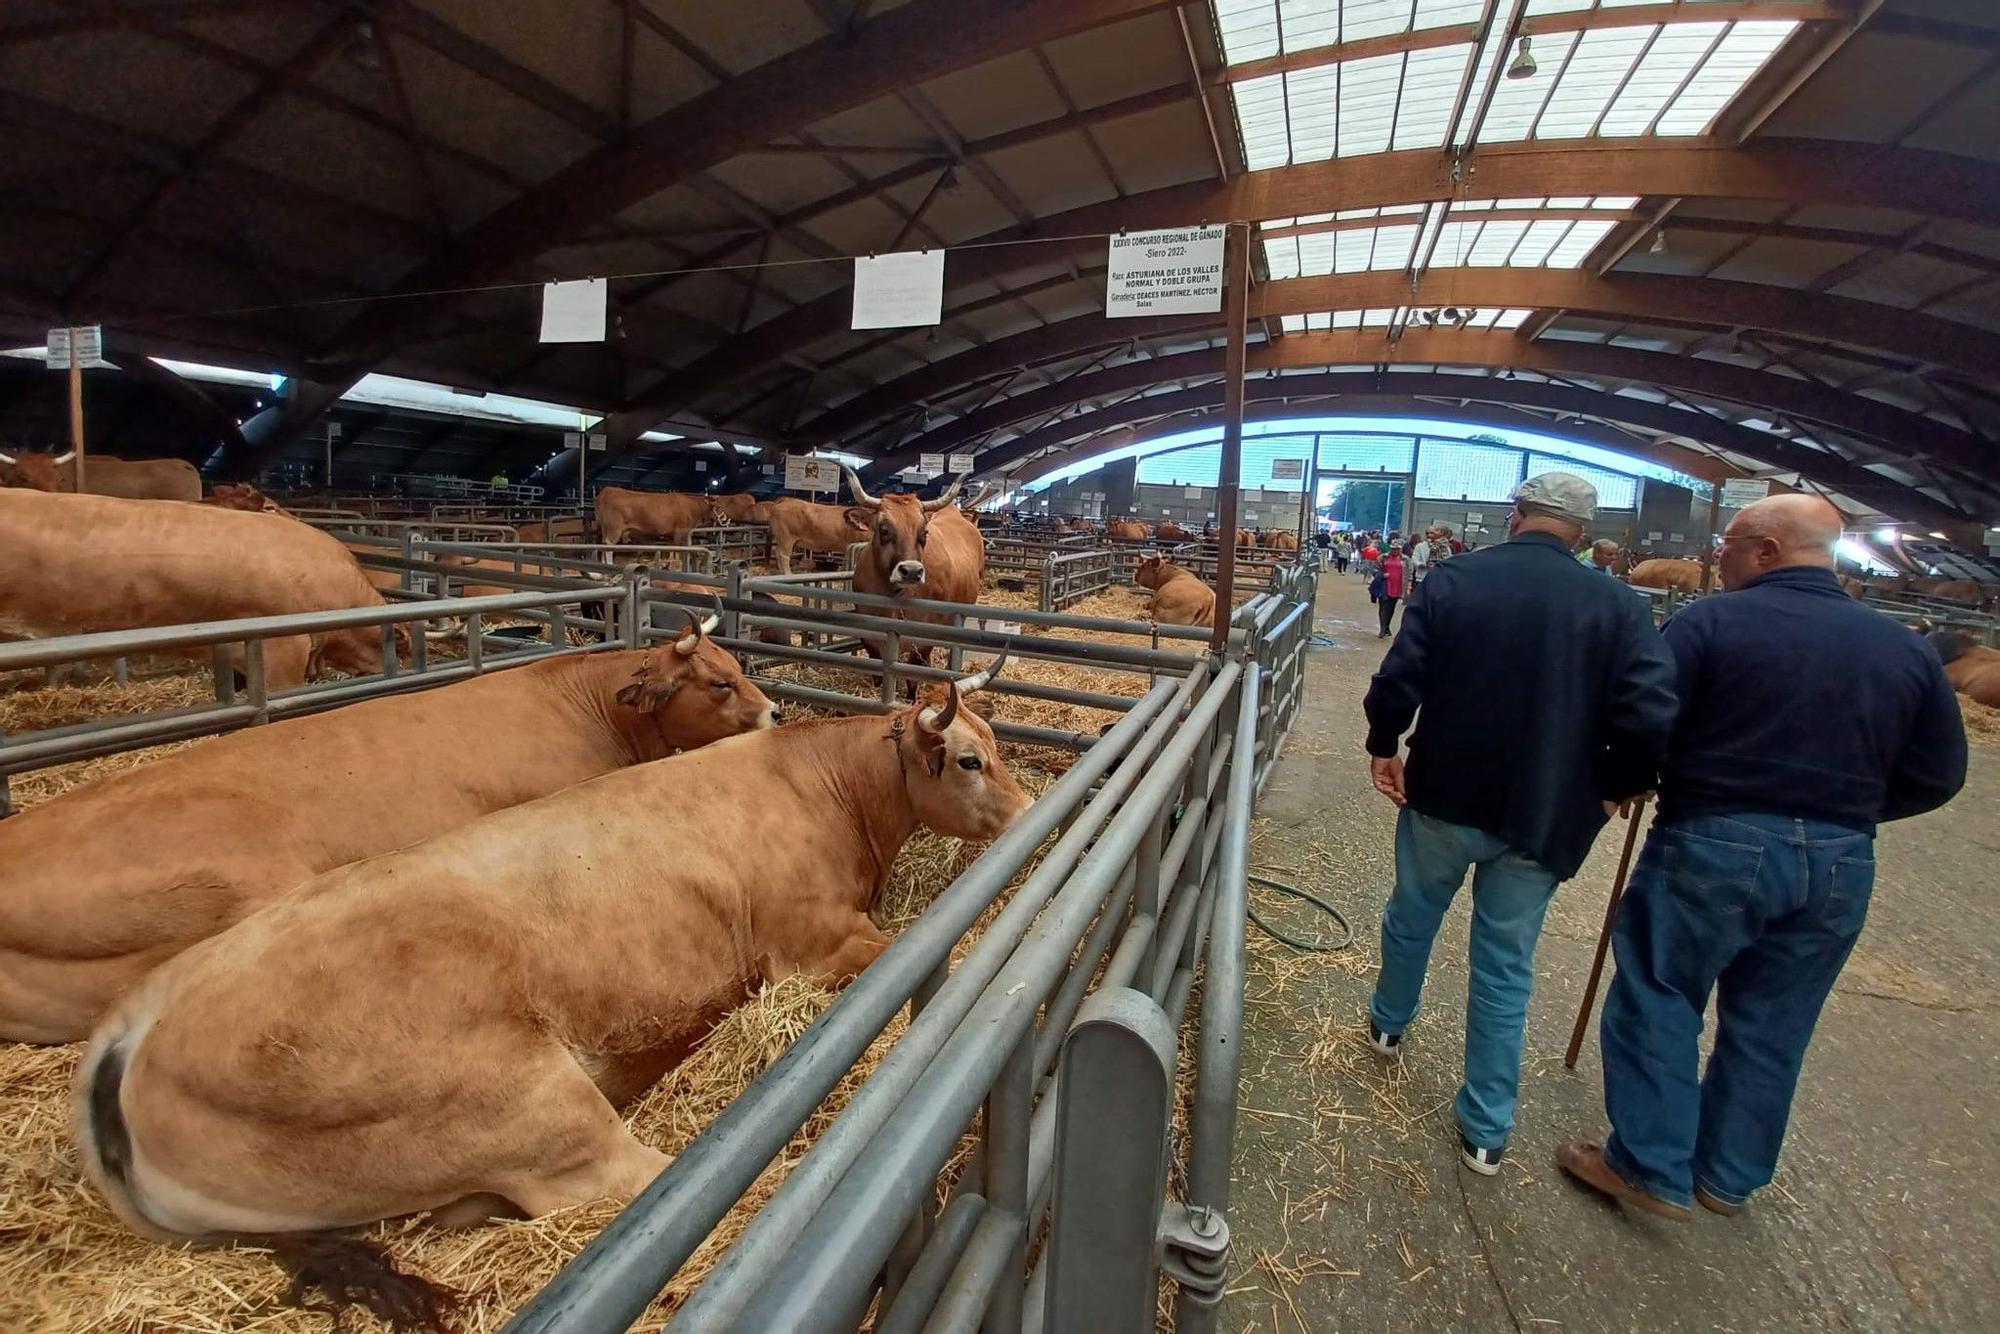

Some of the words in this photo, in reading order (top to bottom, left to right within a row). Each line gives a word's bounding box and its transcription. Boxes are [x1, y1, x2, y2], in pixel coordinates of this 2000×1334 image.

[1132, 235, 1161, 246] CONCURSO
[1162, 233, 1189, 244] REGIONAL
[1191, 231, 1198, 241] DE
[1199, 229, 1222, 240] GANADO
[1168, 246, 1187, 257] 2022-
[1126, 269, 1165, 280] ASTURIANA
[1167, 268, 1176, 277] DE
[1178, 267, 1191, 276] LOS
[1192, 264, 1219, 275] VALLES
[1125, 279, 1154, 288] NORMAL
[1156, 278, 1162, 286] Y
[1162, 276, 1185, 286] DOBLE
[1187, 274, 1210, 284] GRUPA
[1193, 287, 1218, 296] HÉCTOR
